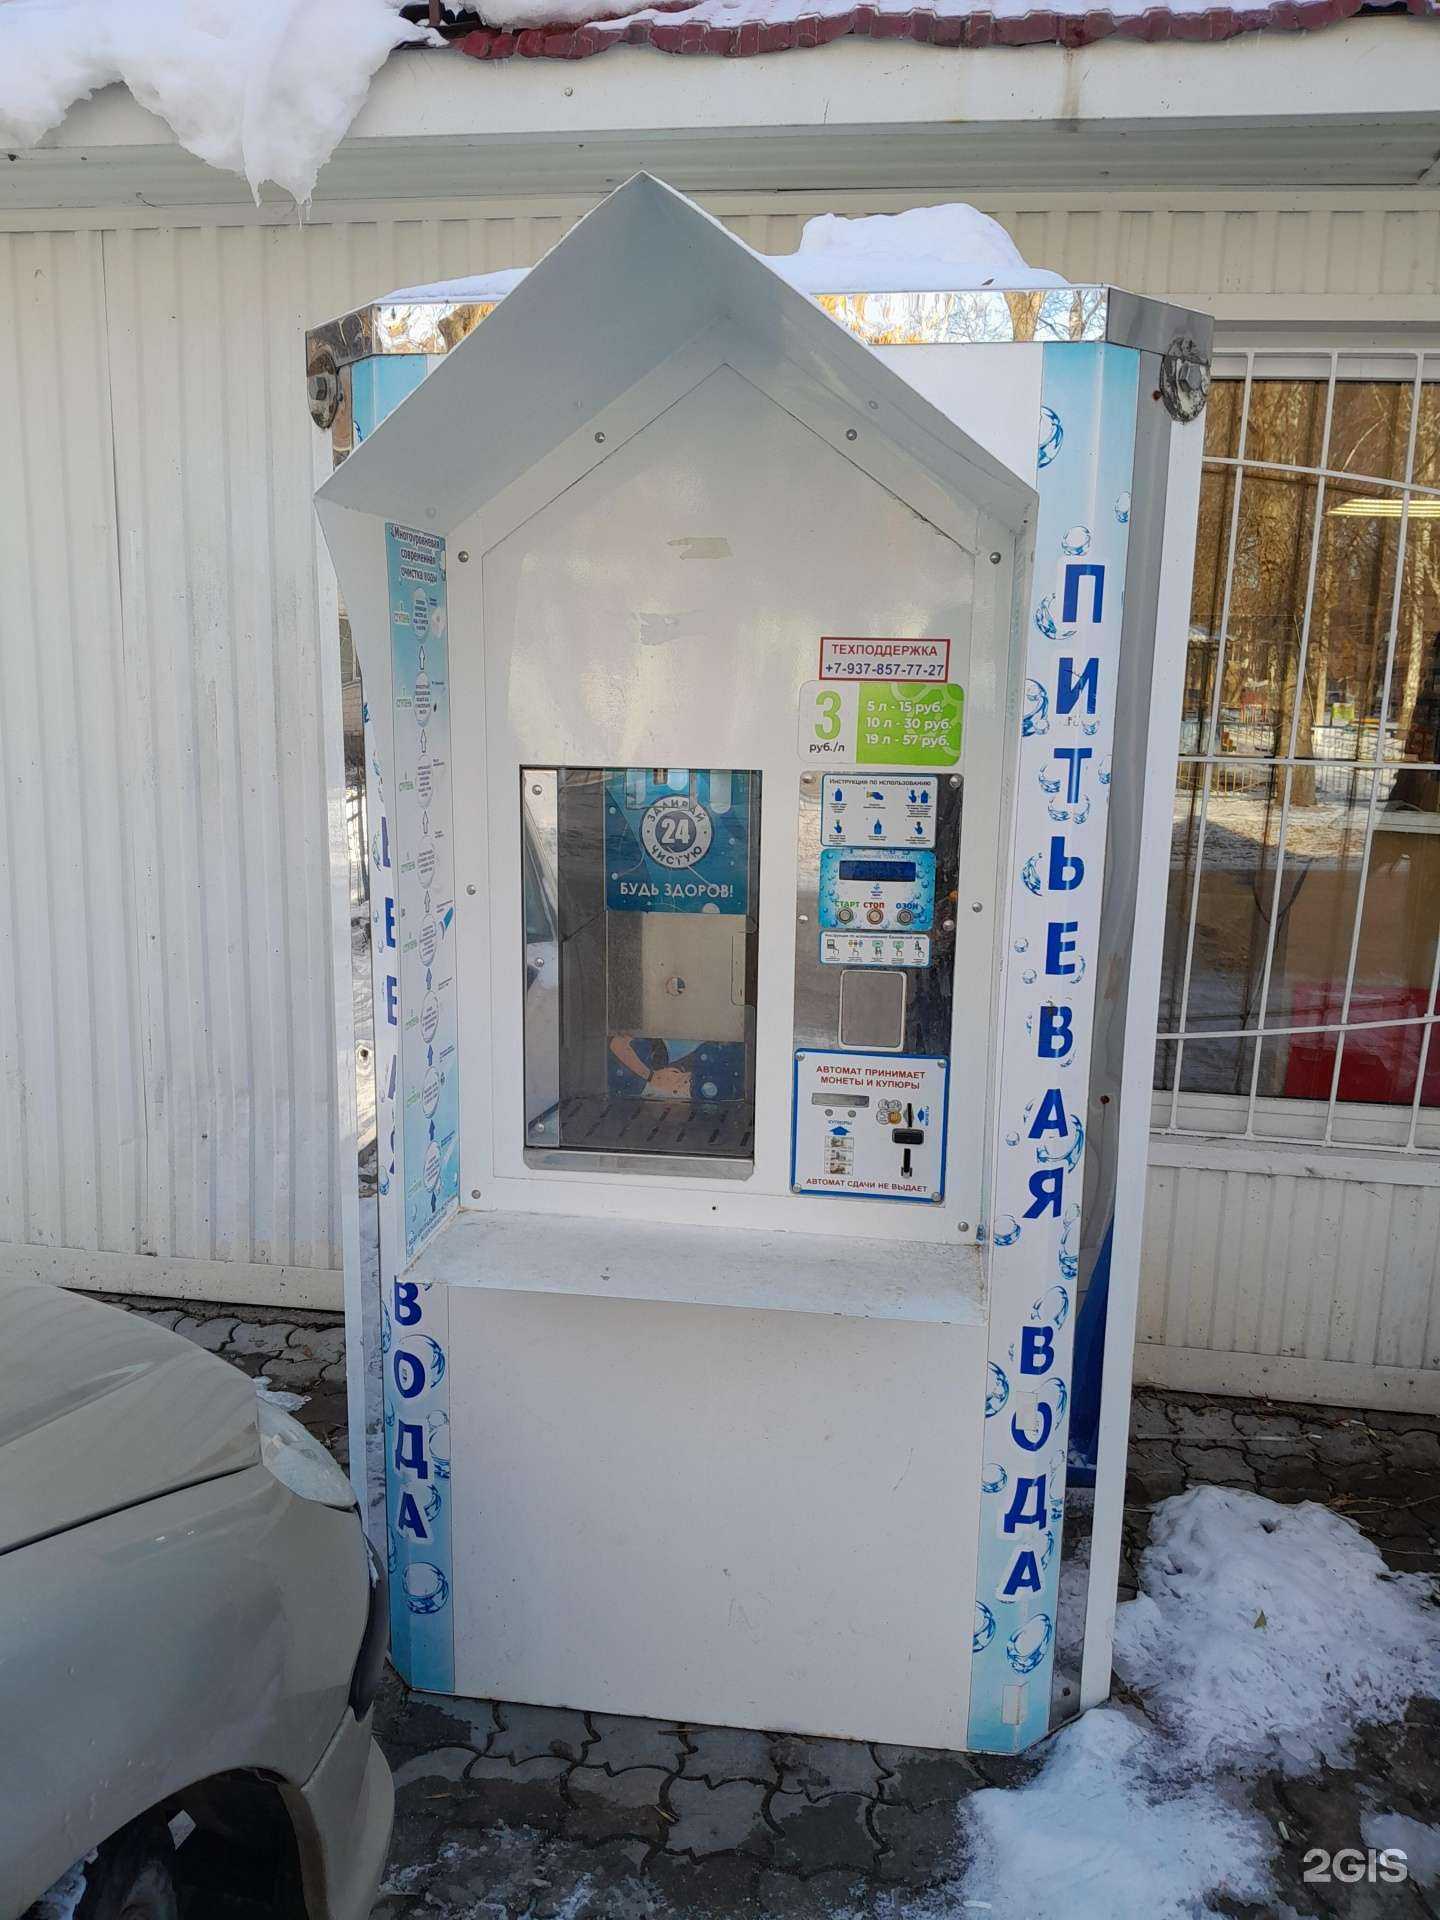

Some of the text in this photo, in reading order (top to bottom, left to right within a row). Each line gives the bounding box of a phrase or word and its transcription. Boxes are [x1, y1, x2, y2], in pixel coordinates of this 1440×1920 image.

[831, 643, 938, 657] ТЕХПОДДЕРЖКА
[825, 662, 945, 677] +7-937-857-77-27
[814, 690, 842, 740] 3
[866, 701, 875, 712] 5
[878, 703, 887, 712] л
[900, 701, 911, 712] 15
[915, 701, 943, 716] руб.
[865, 716, 880, 729] 10
[883, 719, 892, 729] л
[904, 717, 920, 729] 30
[924, 718, 952, 732] руб.
[809, 741, 845, 753] руб./л
[865, 733, 879, 745] 19
[882, 735, 891, 745] л
[903, 734, 918, 745] 57
[921, 734, 950, 748] руб.
[661, 818, 691, 844] 24
[650, 844, 703, 865] ЧИСТУЮ
[620, 882, 734, 898] БУДЬ ЗДОРОВ!
[835, 901, 919, 910] СТАРТ СТОП ОЗОН
[816, 1065, 926, 1080] АВТОМАТ ПРИНИМАЕТ
[1003, 563, 1105, 1596] ПИТЬЕВАЯ ВОДА
[820, 1076, 920, 1090] МОНЕТЫ И КУПЮРЫ
[806, 1178, 928, 1193] АВТОМАТ СДАЧИ НЕ ВЫДАЕТ
[394, 1281, 429, 1539] ВОДА
